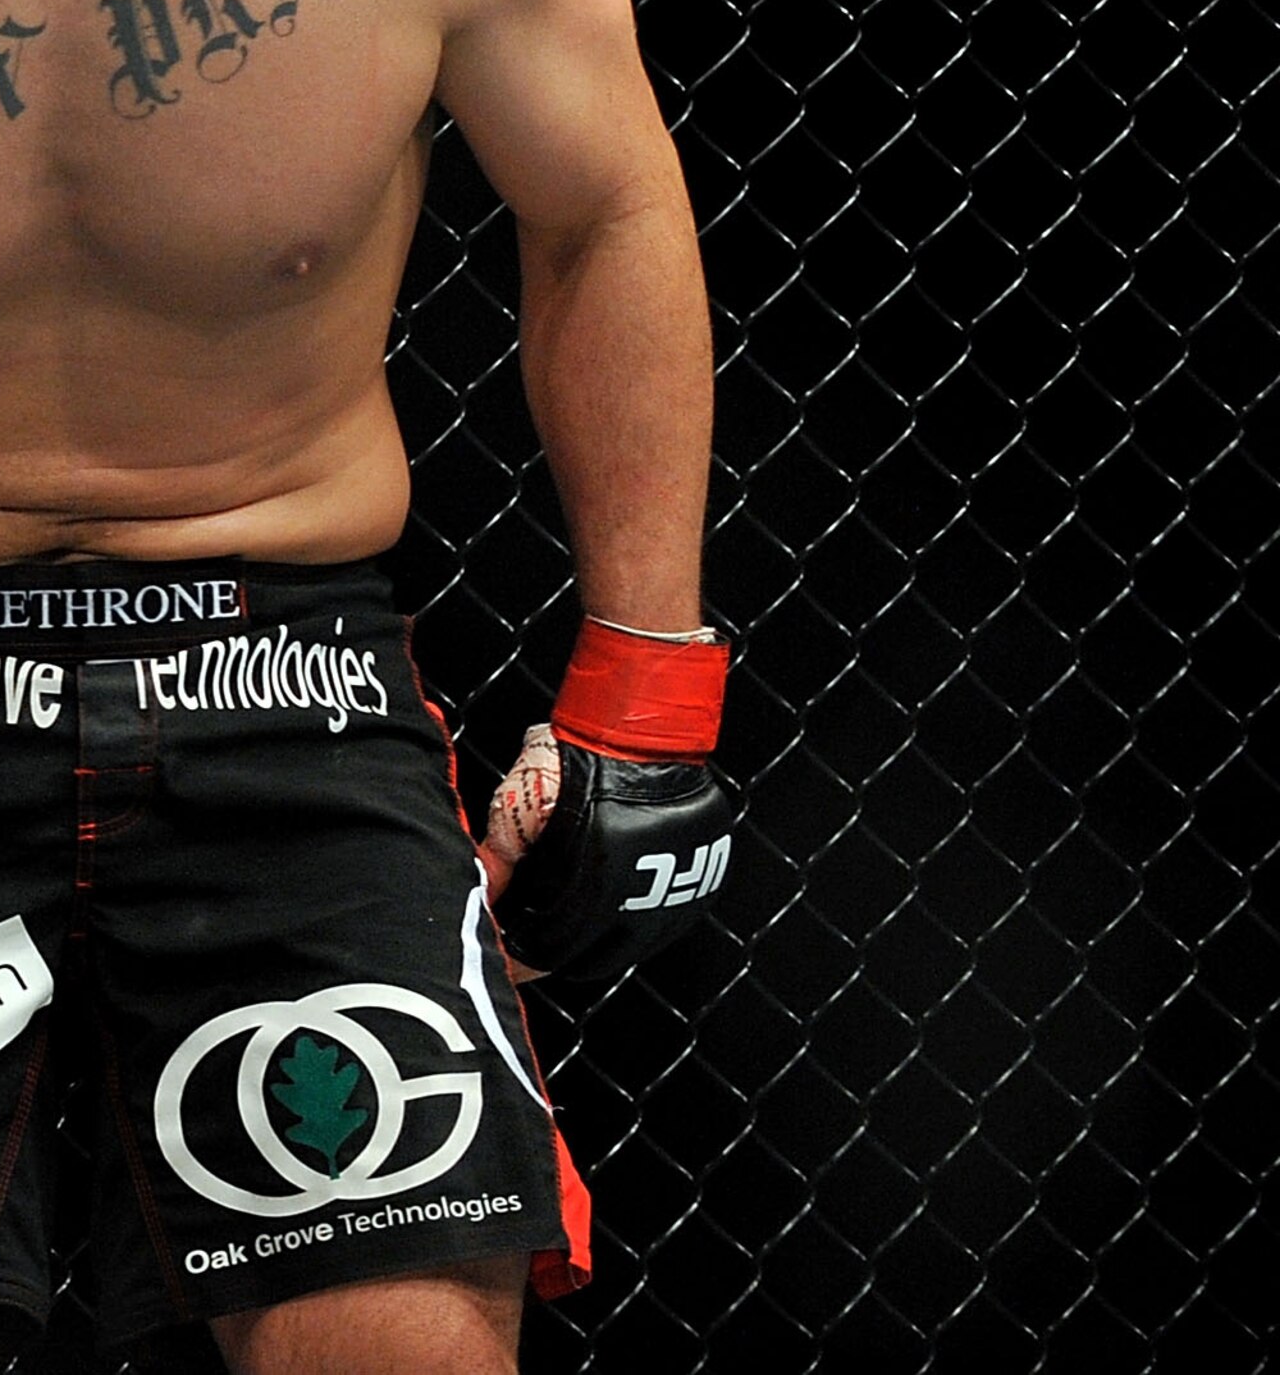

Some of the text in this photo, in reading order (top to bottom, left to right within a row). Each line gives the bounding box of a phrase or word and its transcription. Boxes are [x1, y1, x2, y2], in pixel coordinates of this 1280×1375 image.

[623, 834, 732, 911] UFC
[184, 1193, 523, 1274] Oak Grove Technologies
